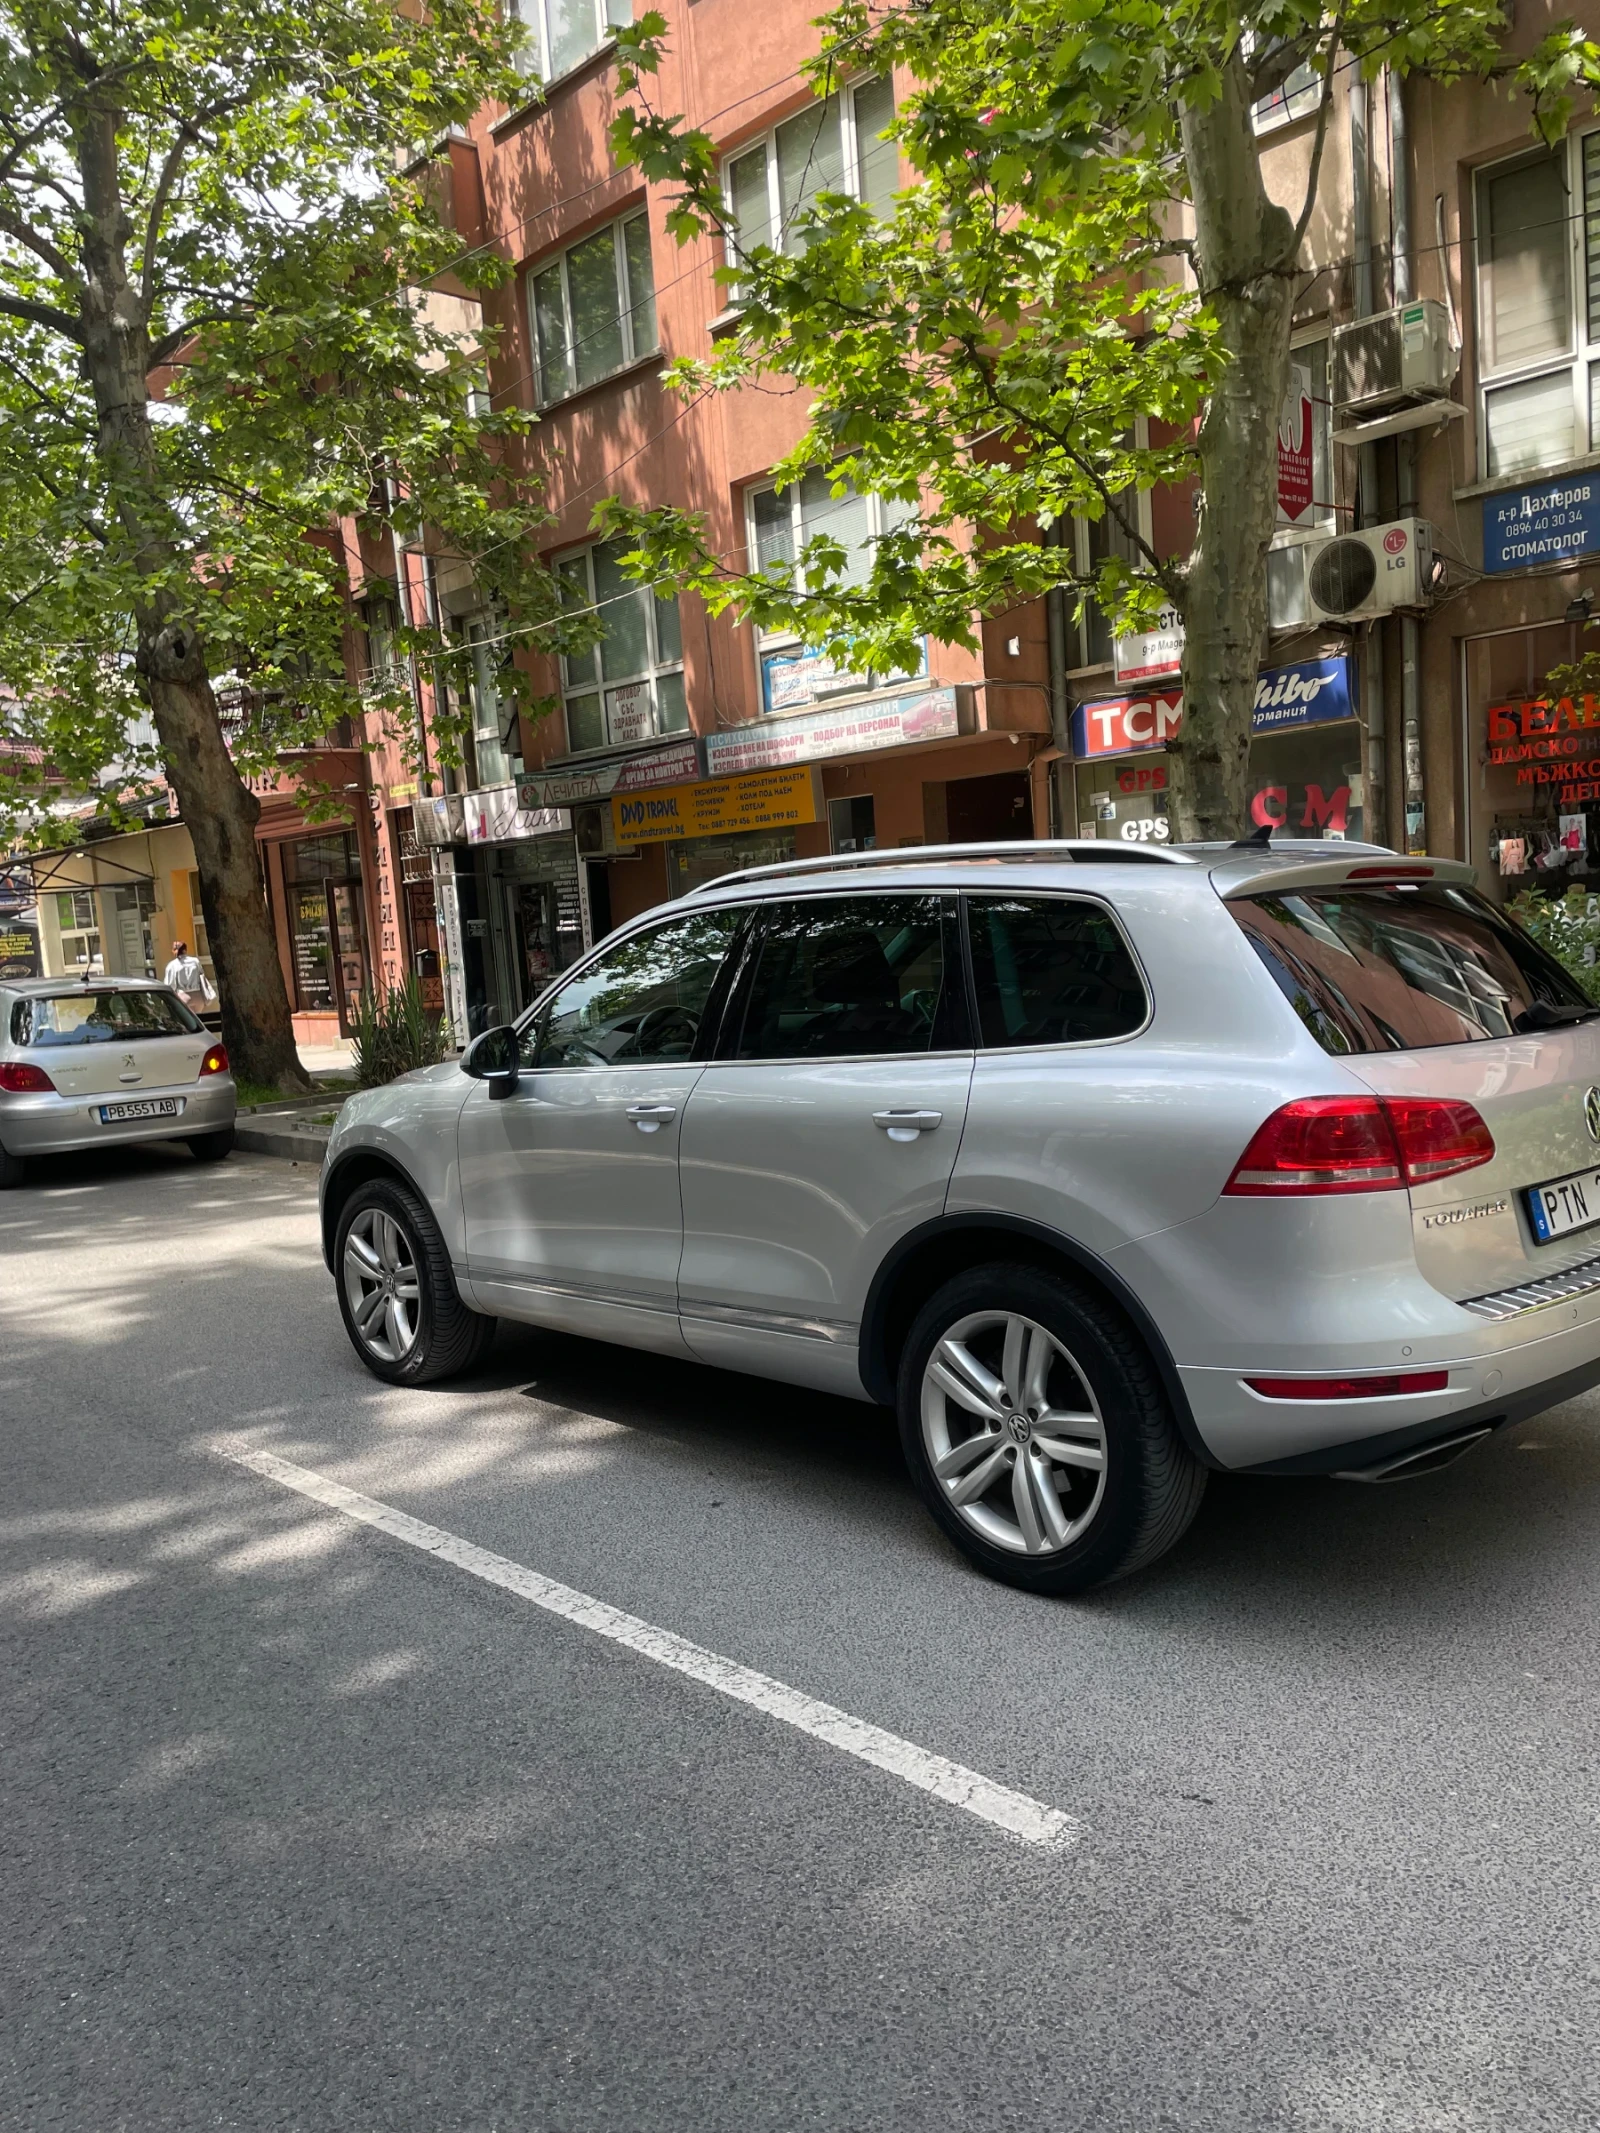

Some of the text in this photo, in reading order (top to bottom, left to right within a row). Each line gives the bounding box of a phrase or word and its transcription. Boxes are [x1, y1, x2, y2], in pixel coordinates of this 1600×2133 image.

[1498, 486, 1591, 523] д-р Дахтеров
[1506, 510, 1583, 538] 0896 40 30 34
[1502, 530, 1589, 561] СТОМАТОЛОГ
[1387, 556, 1406, 571] LG
[1160, 611, 1186, 630] СТО
[1158, 639, 1186, 652] Младе
[616, 686, 641, 702] ДОГОВОР
[1254, 671, 1338, 710] hibo
[621, 703, 635, 715] СЪС
[613, 713, 647, 730] ЗДРАВНАТА
[813, 726, 845, 744] ПОДБОР
[846, 724, 857, 736] НА
[858, 715, 901, 734] ПЕРСОНАЛ
[622, 728, 638, 741] КАСА
[711, 744, 756, 760] ИЗСЛЕДВАНЕ
[757, 743, 766, 753] НА
[766, 734, 805, 751] ШОФЬОРИ
[1490, 736, 1579, 765] ДАМСКО
[625, 769, 646, 783] ОРГАН
[655, 762, 685, 779] КОНТРОЛ
[713, 756, 758, 773] ИЗСЛЕДВАНЕ
[738, 772, 805, 790] САМОЛЕТНИ БИЛЕТИ
[1118, 766, 1166, 793] GPS
[544, 775, 601, 804] ЛЕЧИТЕЛ
[740, 786, 793, 801] КОЛИ ПОД НАЕМ
[621, 797, 679, 827] DND TRAVEL
[695, 797, 725, 808] ПОЧИВКИ
[740, 802, 766, 812] ХОТЕЛИ
[712, 819, 726, 829] 0887
[727, 818, 738, 827] 729
[739, 816, 751, 826] 456
[773, 812, 785, 821] 999
[786, 810, 799, 819] 802
[1121, 816, 1169, 842] GPS
[620, 823, 685, 840] www.dndtravel.bg
[109, 1100, 174, 1120] PB 5551 AB
[1544, 1181, 1589, 1229] PTN
